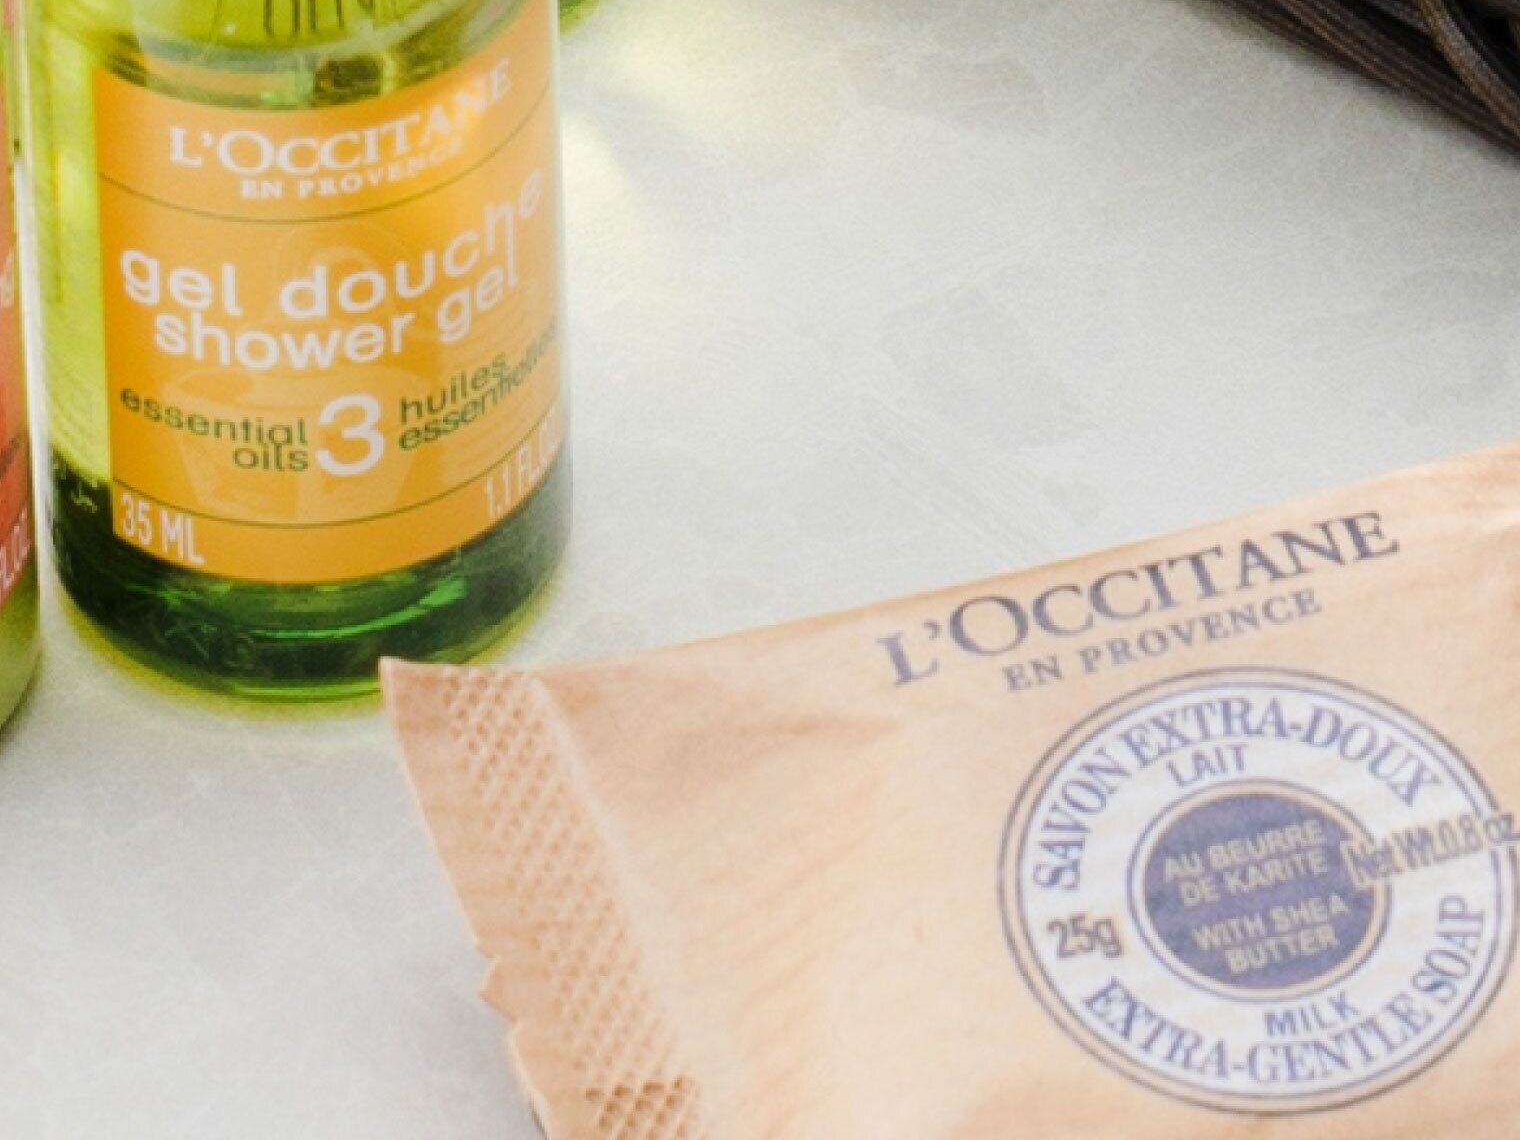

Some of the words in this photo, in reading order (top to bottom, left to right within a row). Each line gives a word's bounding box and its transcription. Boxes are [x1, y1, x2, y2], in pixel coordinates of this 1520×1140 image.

[168, 58, 511, 175] L'OCCITANE
[240, 178, 283, 200] EN
[298, 138, 463, 198] PROVENCE
[120, 247, 242, 317] gel
[279, 169, 543, 320] douche
[154, 310, 416, 372] shower
[436, 232, 520, 344] gel
[400, 353, 508, 425] huiles
[119, 387, 308, 447] essential
[232, 440, 310, 473] oils
[316, 393, 387, 477] 3
[122, 491, 154, 547] 35
[159, 510, 206, 564] ML
[877, 511, 1400, 686] L'OCCITANE
[1001, 655, 1063, 692] EN
[1079, 588, 1322, 673] PROVENCE
[1032, 732, 1133, 892] SAVON
[1123, 697, 1443, 808] EXTRA-DOUX
[1166, 742, 1249, 789] LAIT
[1165, 851, 1204, 883] AU
[1208, 819, 1323, 871] BEURRE
[1181, 876, 1221, 907] DE
[1191, 912, 1267, 951] WITH
[1270, 892, 1350, 933] SHEA
[1047, 915, 1123, 960] 25g
[1225, 923, 1341, 976] BUTTER
[1082, 976, 1434, 1085] EXTRA-GENTLE
[1413, 892, 1487, 1007] SOAP
[1264, 989, 1365, 1038] MILK
